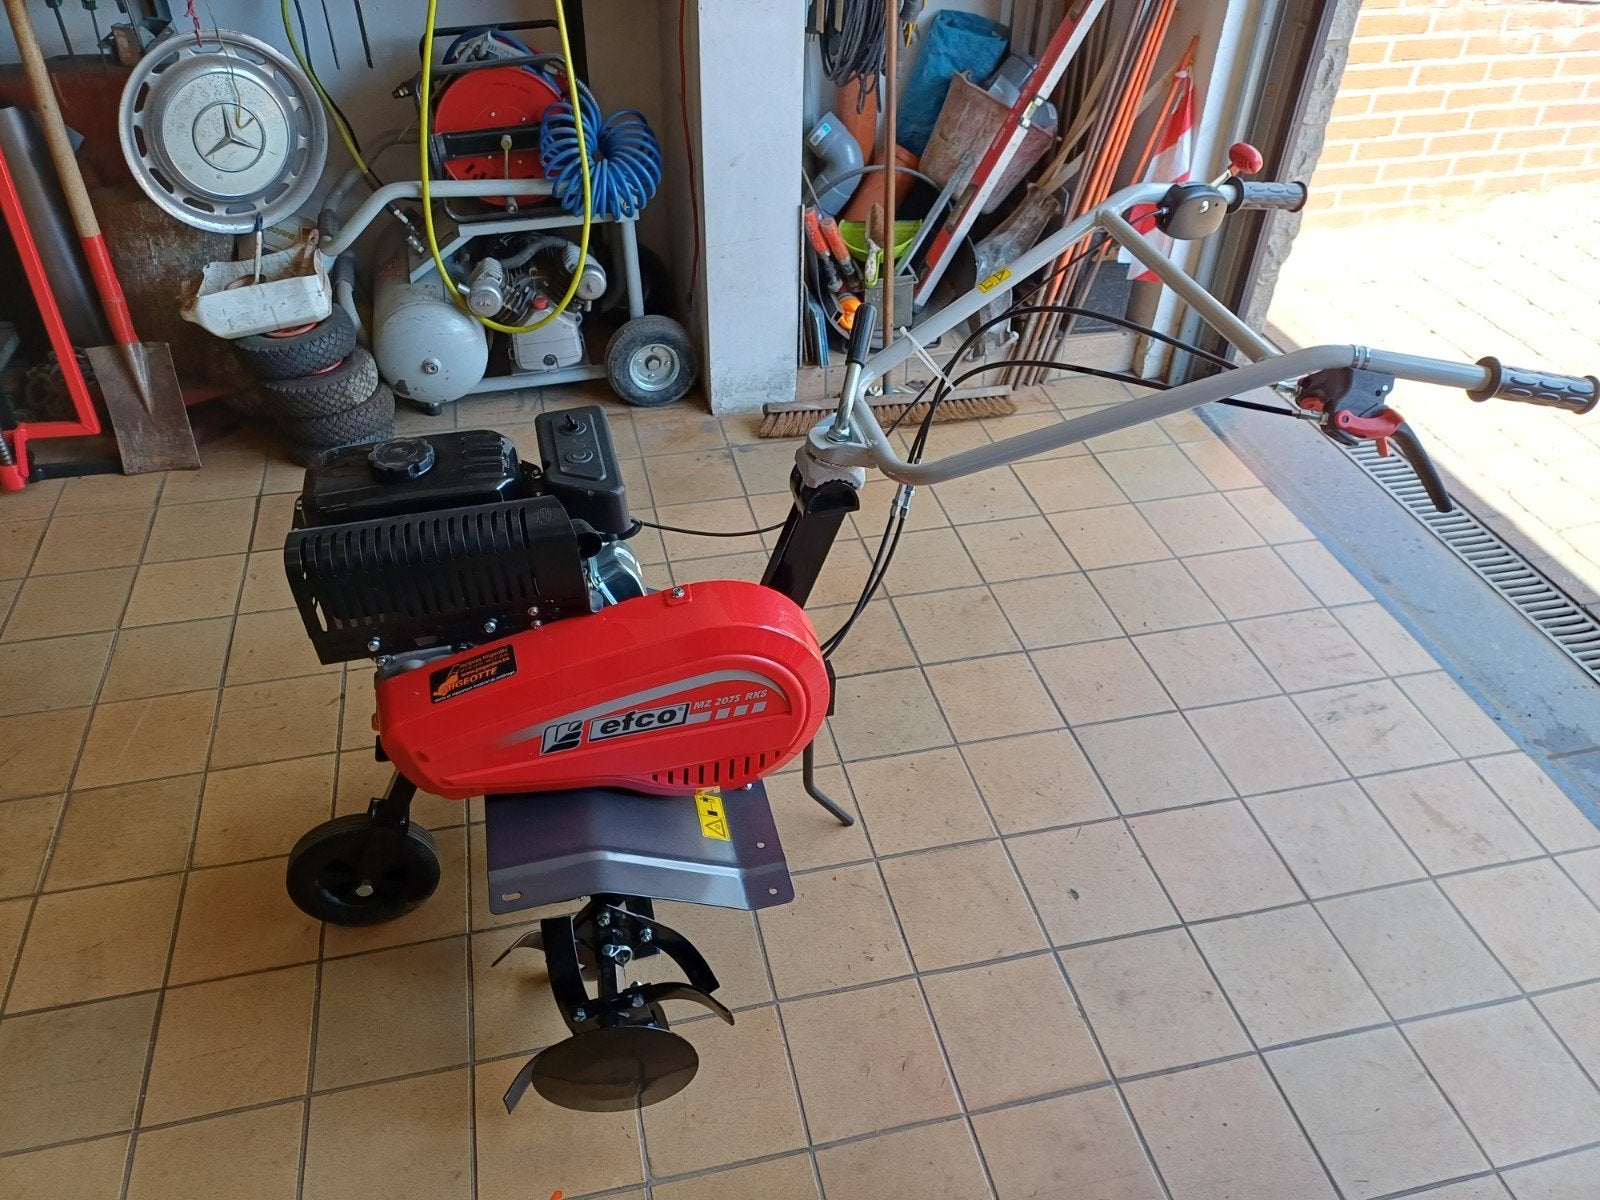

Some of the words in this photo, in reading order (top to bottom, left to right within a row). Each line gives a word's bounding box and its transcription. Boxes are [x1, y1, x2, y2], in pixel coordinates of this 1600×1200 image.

[443, 666, 498, 692] MIGEOTTE
[694, 699, 712, 710] MZ
[715, 694, 741, 706] 2075
[745, 689, 768, 701] RKS
[600, 710, 678, 735] efco
